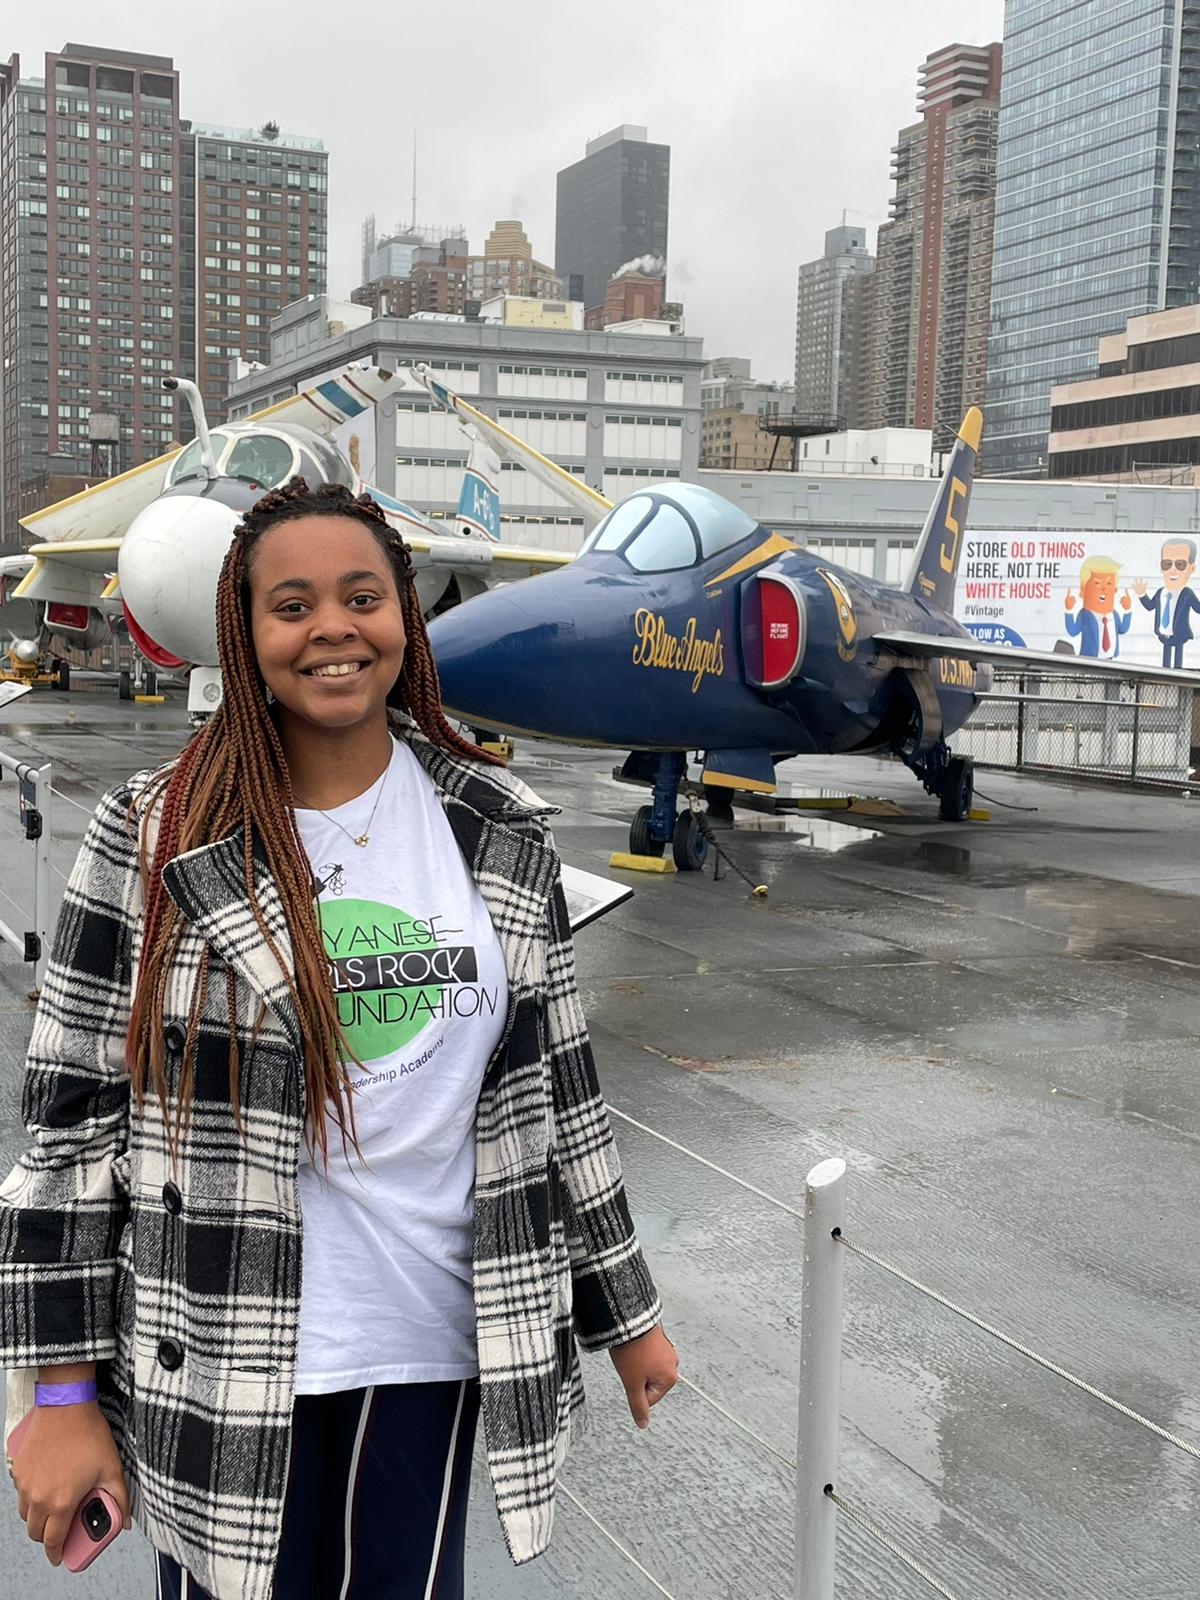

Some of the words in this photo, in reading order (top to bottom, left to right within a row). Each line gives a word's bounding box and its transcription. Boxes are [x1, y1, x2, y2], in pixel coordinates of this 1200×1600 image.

[967, 542, 1008, 558] STORE
[1011, 542, 1035, 558] OLD
[1039, 542, 1085, 559] THINGS
[967, 562, 1003, 581] HERE,
[1007, 563, 1033, 578] NOT
[1037, 563, 1060, 579] THE
[966, 582, 1006, 599] WHITE
[1009, 582, 1051, 599] HOUSE
[965, 605, 1004, 617] #Vintage
[994, 628, 1006, 639] AS
[632, 607, 675, 668] Blue
[675, 617, 724, 694] Angels
[323, 915, 463, 952] YANESE
[377, 949, 465, 986] ROCK
[336, 987, 498, 1027] UNDATION
[339, 1070, 397, 1092] adership
[400, 1035, 445, 1076] Academy
